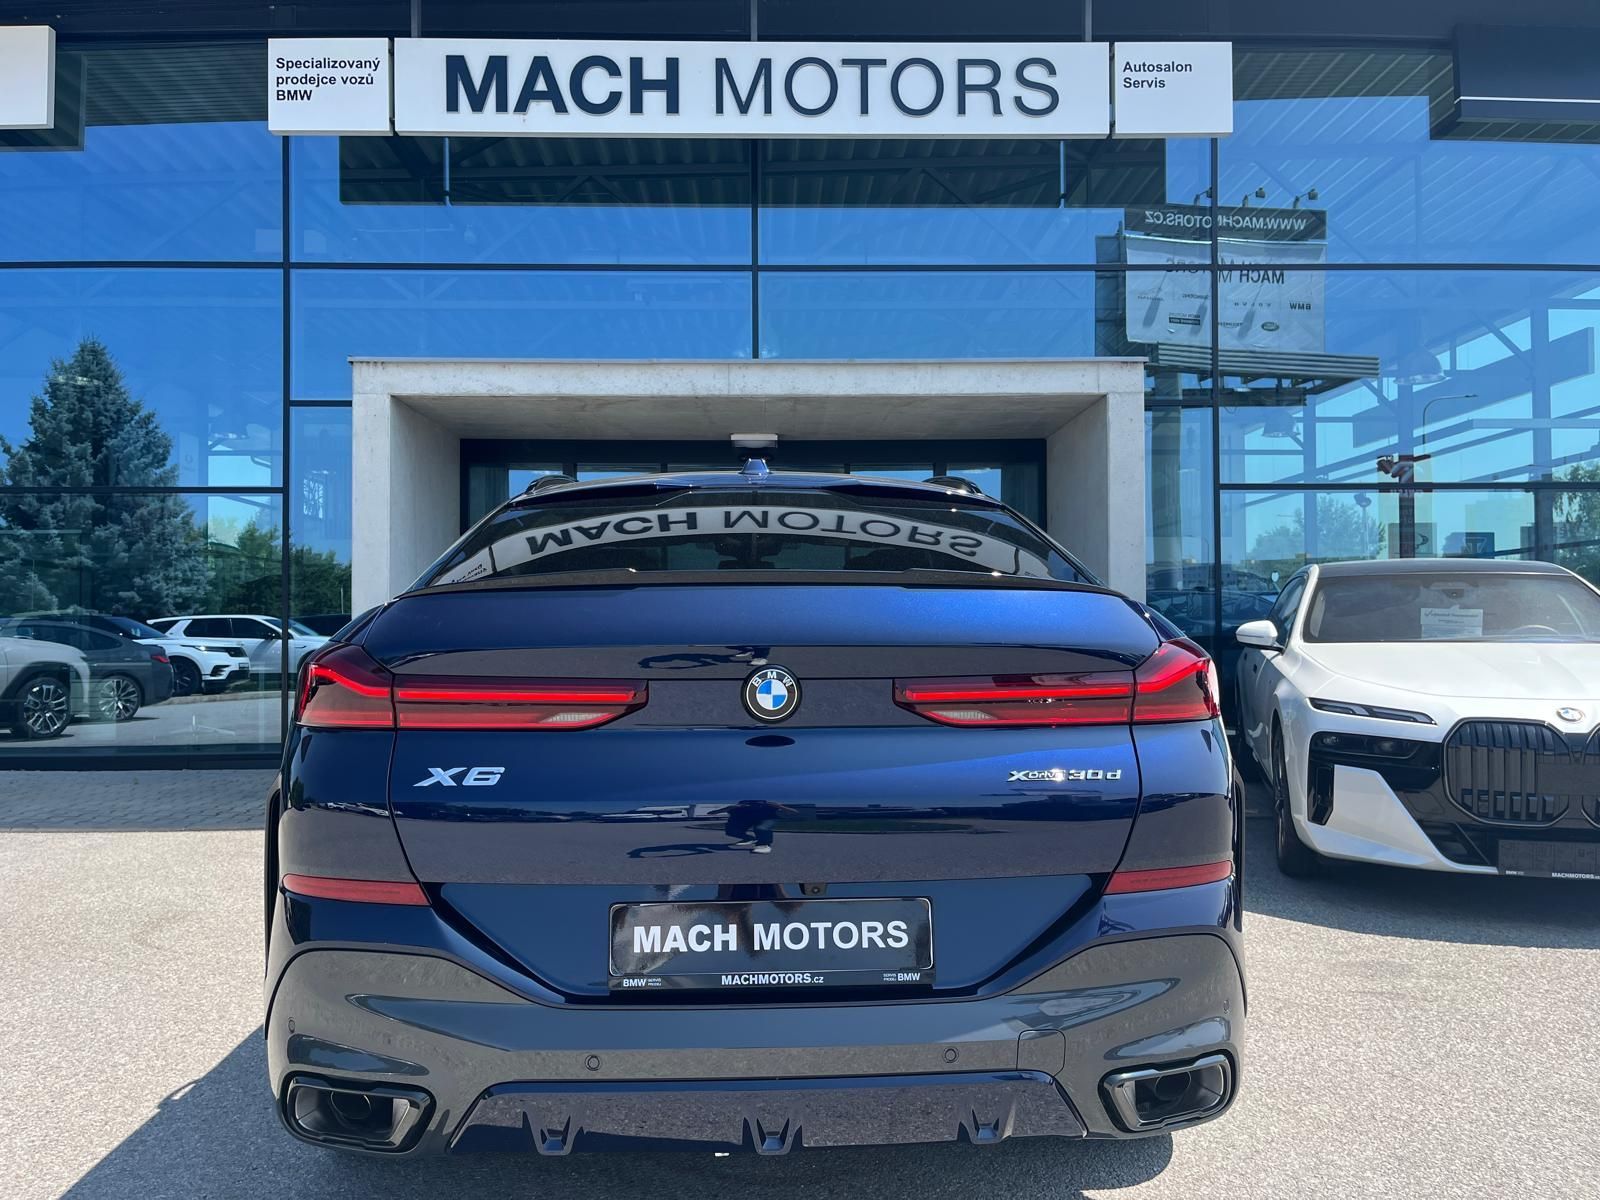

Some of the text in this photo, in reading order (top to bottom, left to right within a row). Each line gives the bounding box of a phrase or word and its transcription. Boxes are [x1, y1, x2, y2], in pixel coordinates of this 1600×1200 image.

[276, 56, 380, 72] Specializovaný
[1123, 60, 1193, 73] Autosalon
[276, 73, 374, 88] prodejce vozů
[446, 55, 1060, 117] MACH MOTORS
[1123, 77, 1166, 89] Servis
[276, 89, 313, 101] BMW
[751, 671, 793, 687] BMW
[413, 767, 505, 787] X6
[633, 921, 909, 953] MACH MOTORS
[623, 979, 647, 987] BMW
[721, 974, 824, 986] MACHMOTORS.cz
[897, 973, 921, 981] BMW
